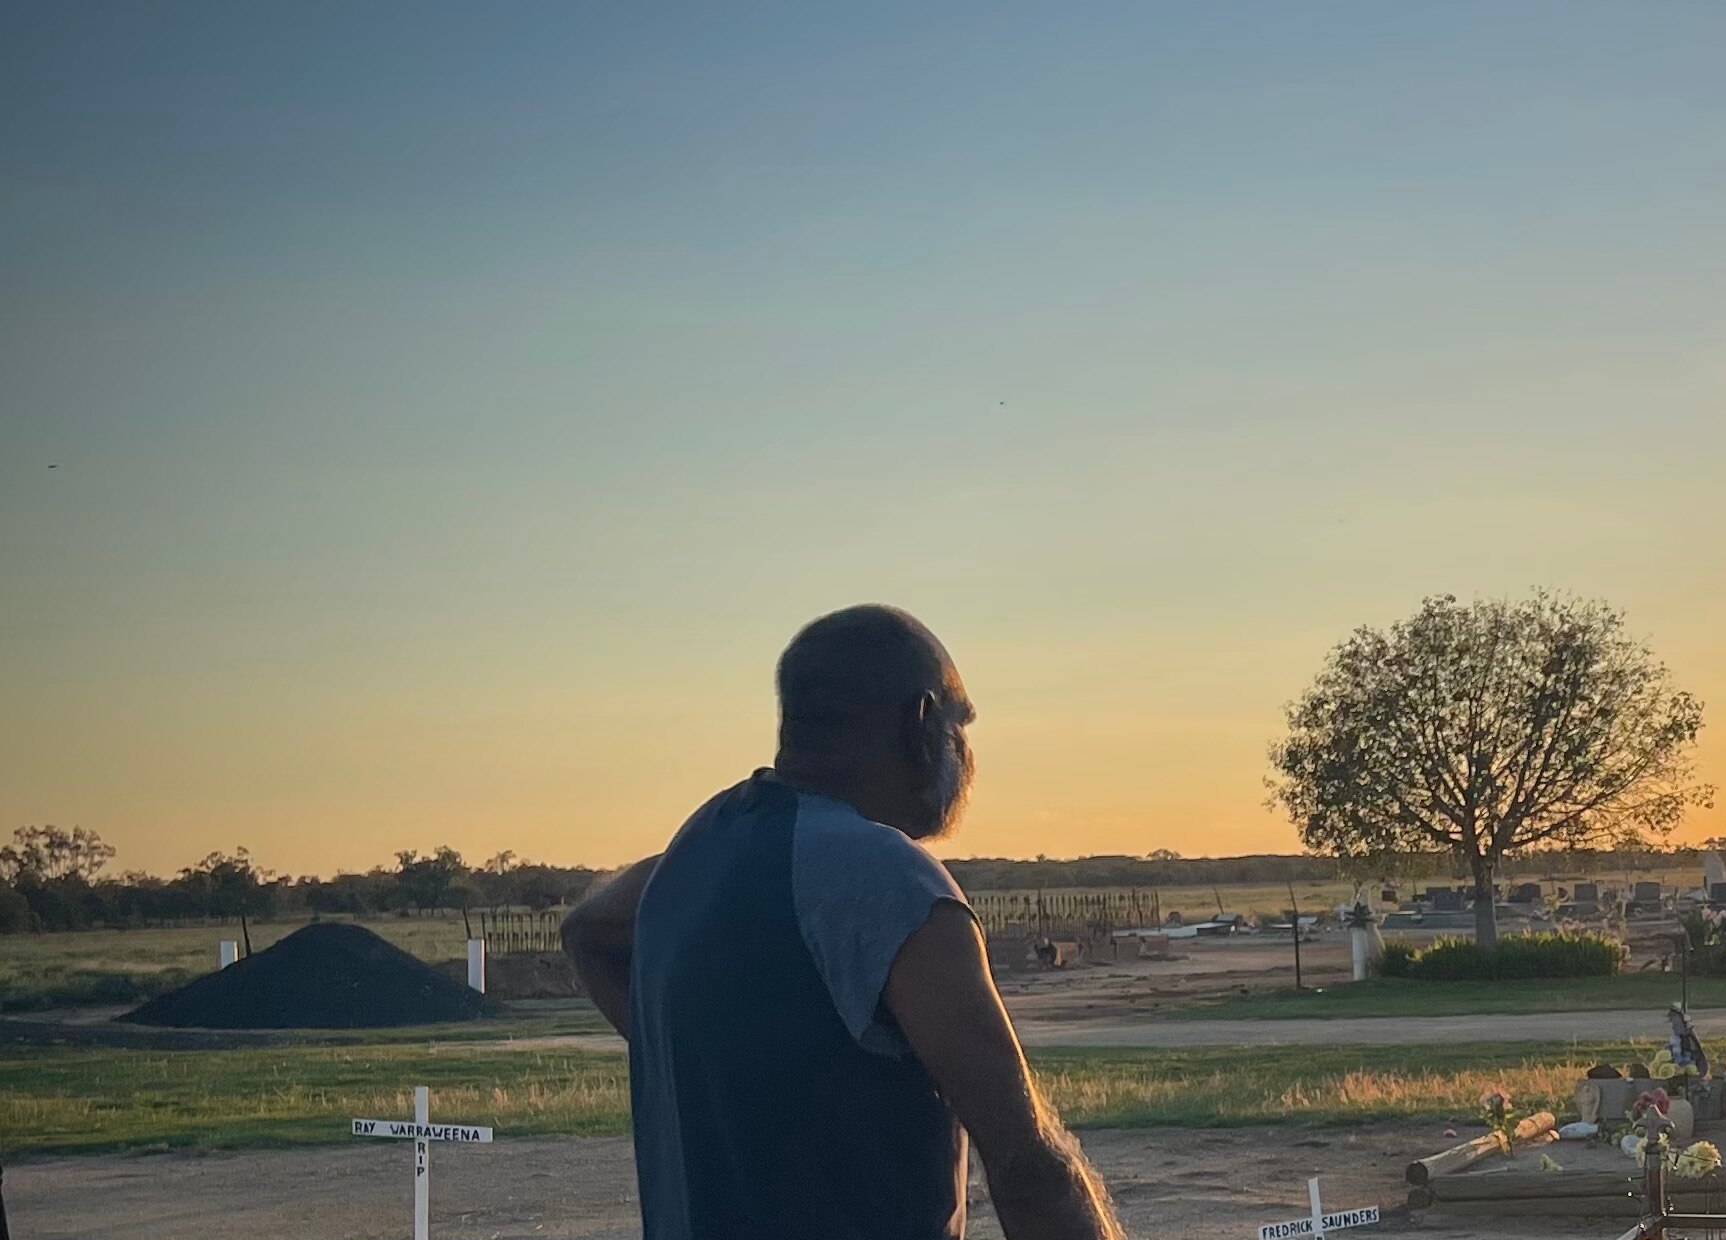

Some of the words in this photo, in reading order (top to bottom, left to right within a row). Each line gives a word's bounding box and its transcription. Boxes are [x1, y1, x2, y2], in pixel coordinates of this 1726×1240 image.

[354, 1120, 376, 1135] RAY
[389, 1123, 481, 1141] WARRAWEENA
[1262, 1220, 1313, 1240] FREDRICK
[1321, 1208, 1379, 1229] SAUNDERS
